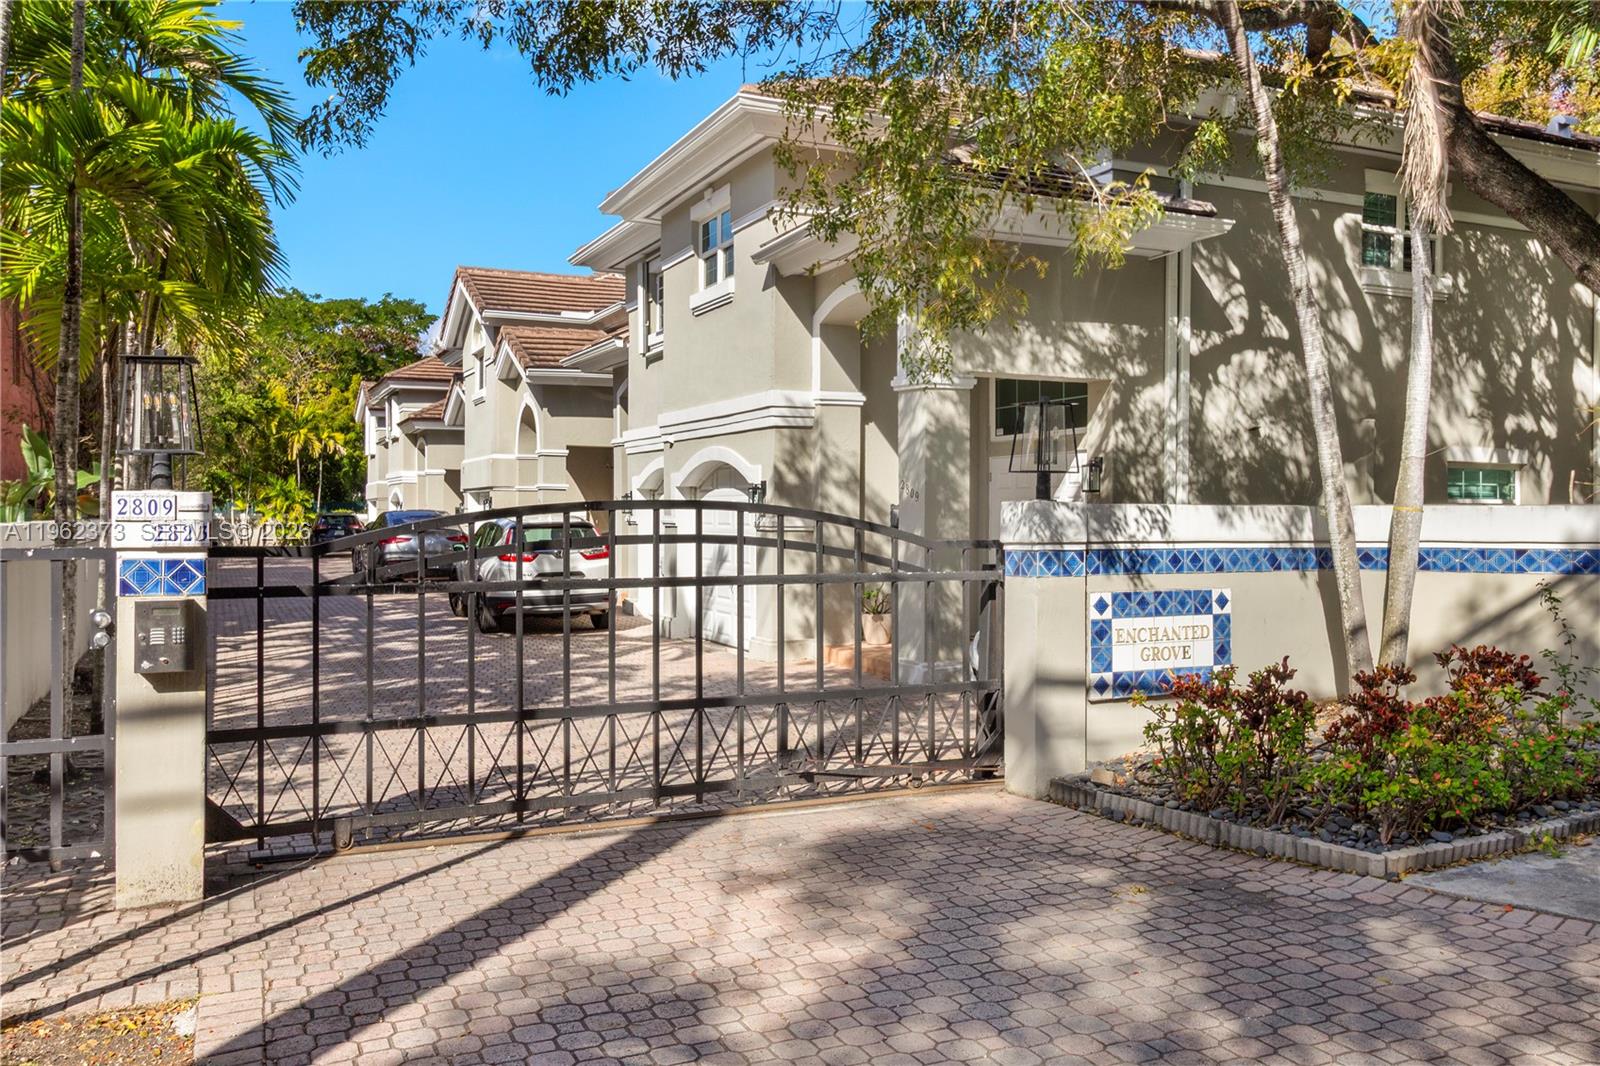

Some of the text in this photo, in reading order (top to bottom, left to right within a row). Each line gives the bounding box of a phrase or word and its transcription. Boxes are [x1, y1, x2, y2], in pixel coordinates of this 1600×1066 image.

[117, 498, 173, 516] 2809
[1115, 625, 1210, 643] ENCHANTED
[1140, 645, 1191, 662] GROVE
